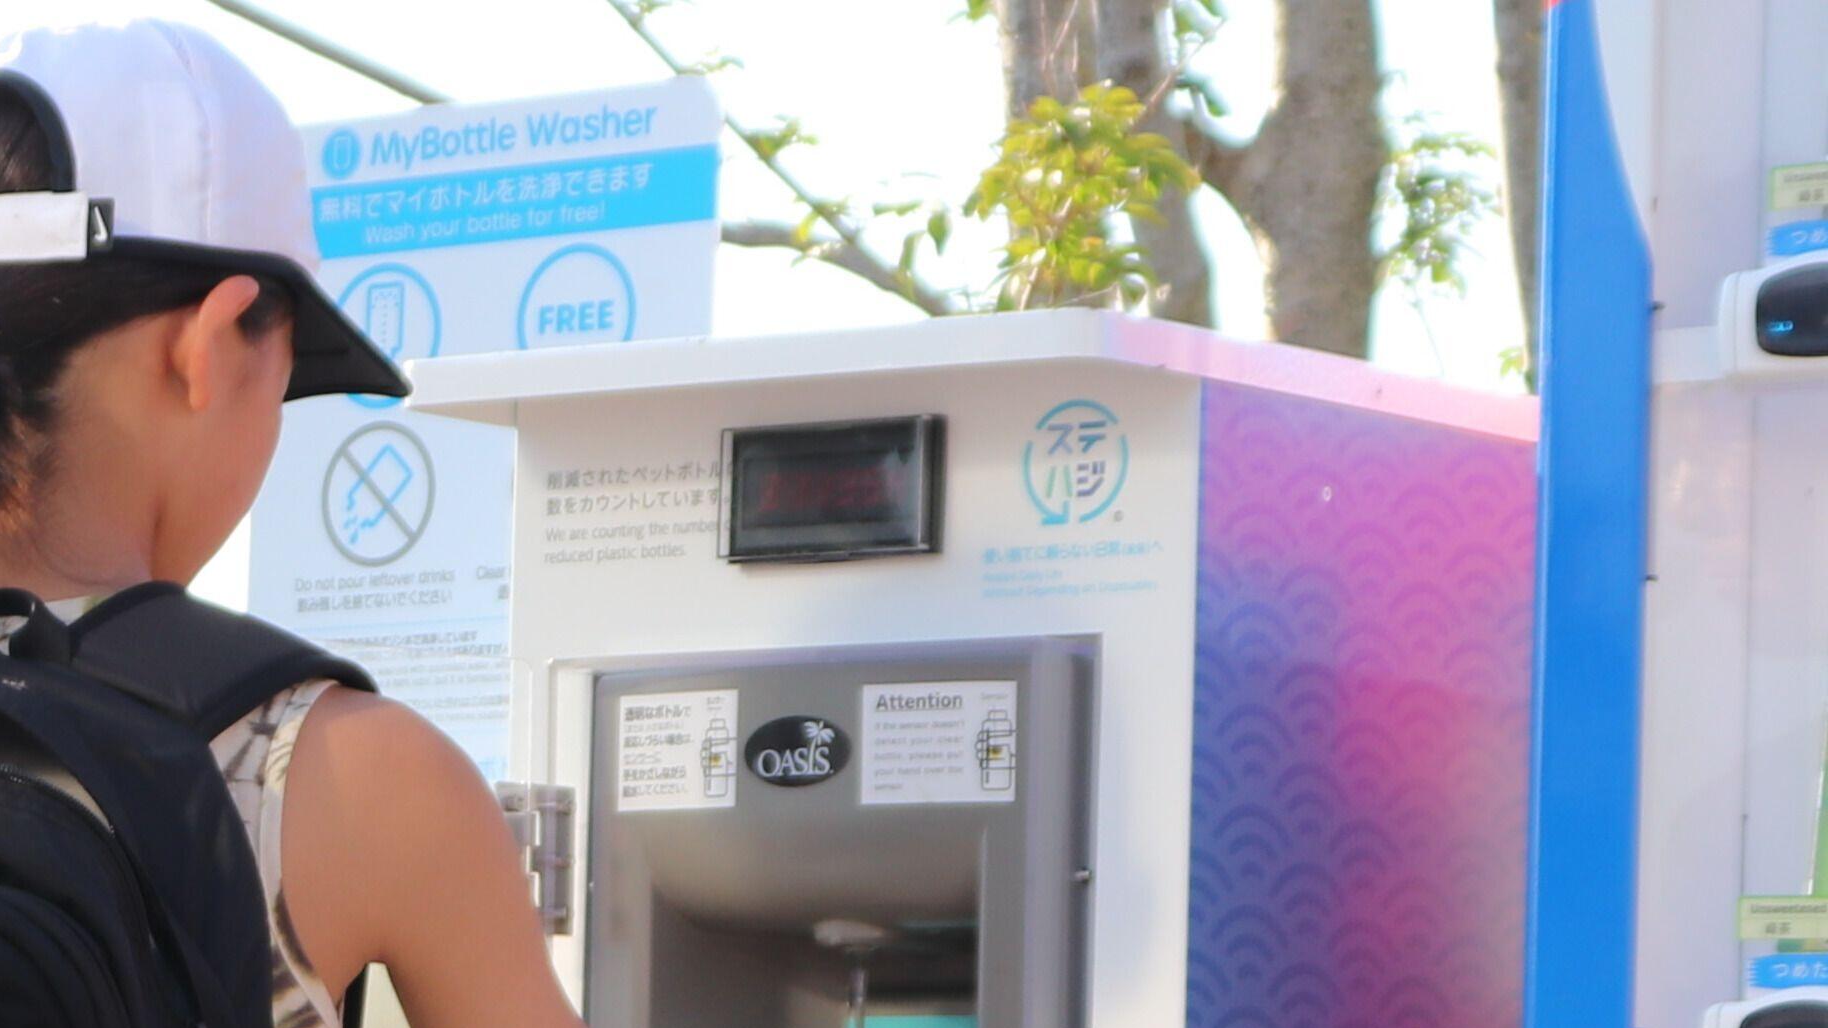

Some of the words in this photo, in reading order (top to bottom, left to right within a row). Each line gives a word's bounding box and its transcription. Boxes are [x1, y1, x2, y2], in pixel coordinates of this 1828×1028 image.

[369, 118, 516, 171] MyBottle
[526, 106, 658, 148] Washer
[319, 162, 654, 222] 無料でマイボトルを洗浄できます
[364, 221, 415, 244] Wash
[419, 219, 462, 242] your
[467, 208, 521, 234] bottle
[526, 206, 555, 228] for
[559, 203, 606, 224] free!
[538, 300, 615, 335] FREE
[545, 526, 566, 543] We
[569, 527, 589, 540] are
[591, 522, 645, 541] counting
[648, 520, 670, 536] the
[544, 547, 594, 564] reduced
[596, 545, 638, 564] plastic
[295, 578, 313, 592] Do
[315, 576, 335, 591] not
[338, 575, 366, 591] pour
[369, 571, 416, 587] leftover
[875, 691, 963, 711] Attention
[757, 740, 832, 778] OASIS
